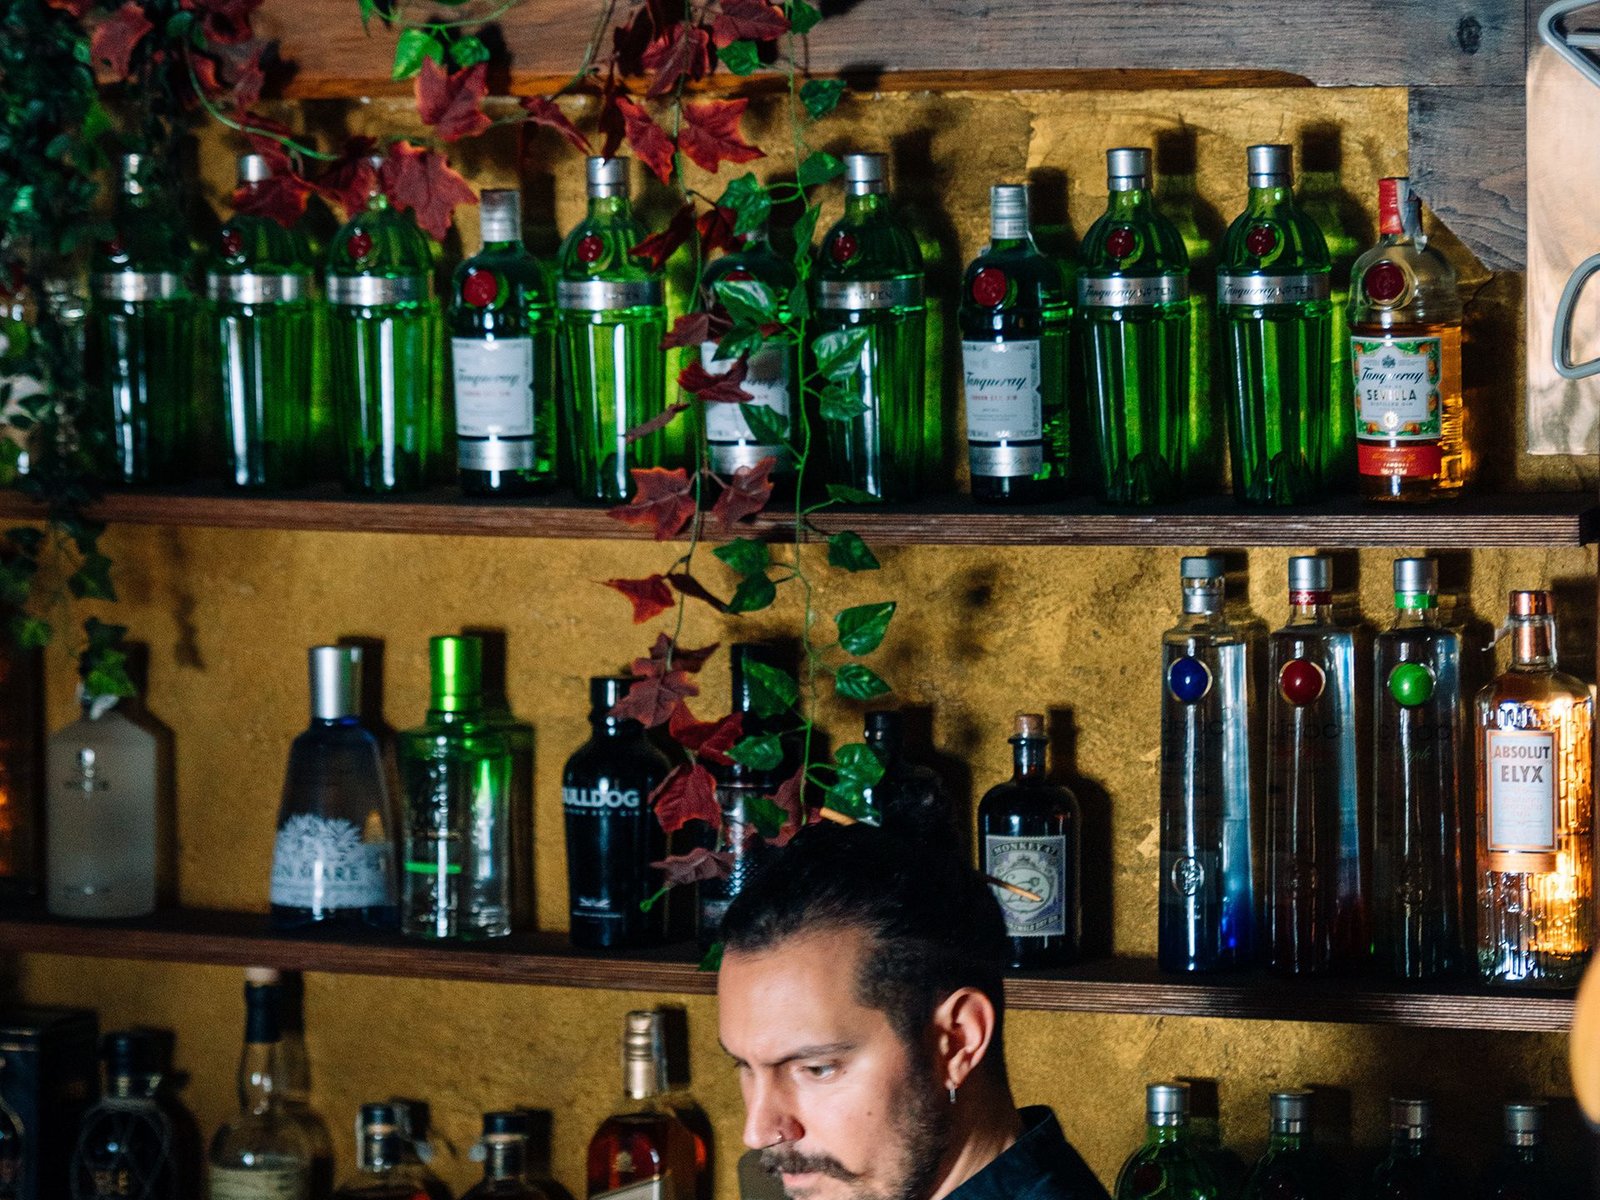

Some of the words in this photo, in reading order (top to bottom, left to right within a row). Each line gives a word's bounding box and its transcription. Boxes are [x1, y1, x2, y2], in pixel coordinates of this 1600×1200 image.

[965, 371, 1027, 392] Tanqueray
[1361, 366, 1424, 384] Tanqueray
[1367, 389, 1417, 401] SEVLLA
[1494, 746, 1550, 759] ABSOLUT
[1501, 765, 1543, 783] ELYX
[993, 842, 1042, 856] MONKEY
